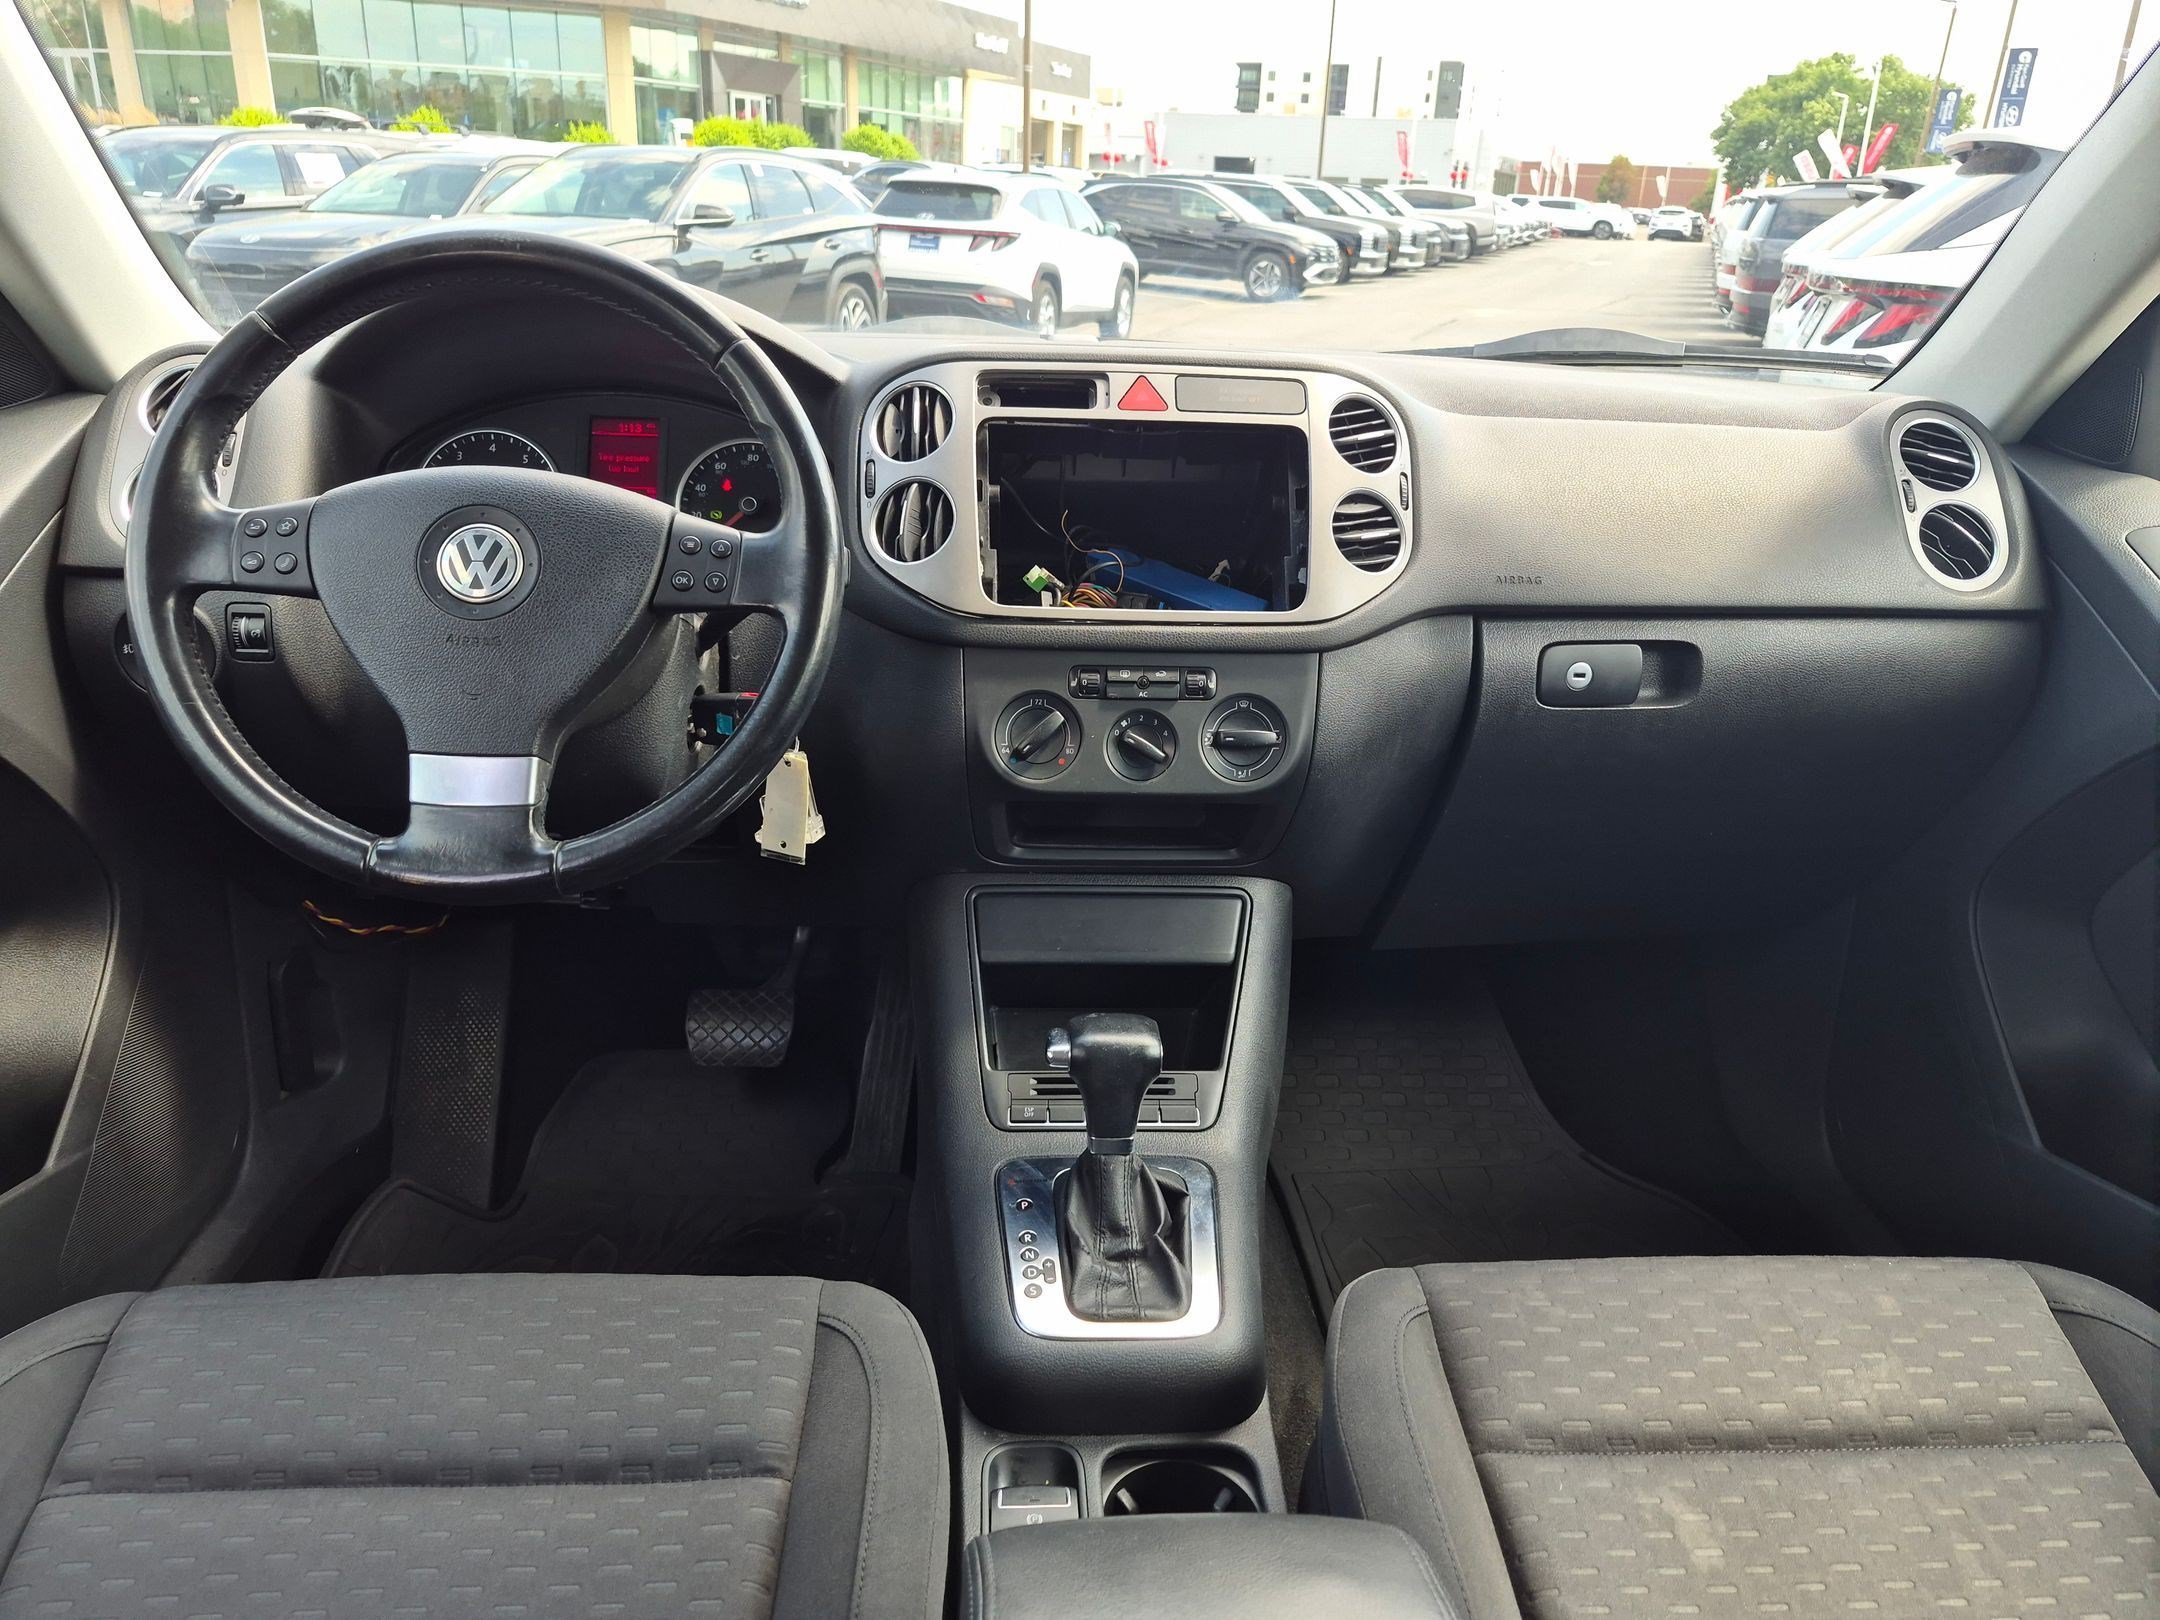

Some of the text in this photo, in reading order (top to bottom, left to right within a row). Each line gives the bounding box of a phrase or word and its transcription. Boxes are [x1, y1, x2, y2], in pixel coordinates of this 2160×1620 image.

[489, 443, 496, 452] 4
[457, 451, 463, 460] 3
[522, 454, 529, 463] 5
[747, 454, 759, 462] 80
[714, 462, 727, 470] 60
[695, 484, 706, 492] 40
[438, 525, 521, 601] VW
[675, 576, 689, 584] OK
[1496, 575, 1543, 585] AIRBAG
[1034, 698, 1043, 706] 72
[1139, 714, 1145, 722] 2
[1001, 746, 1011, 754] 64
[1065, 747, 1075, 755] 80
[1021, 1202, 1029, 1210] P
[1024, 1233, 1032, 1243] R
[1025, 1250, 1035, 1260] N
[1027, 1268, 1037, 1277] D
[1029, 1286, 1037, 1296] S
